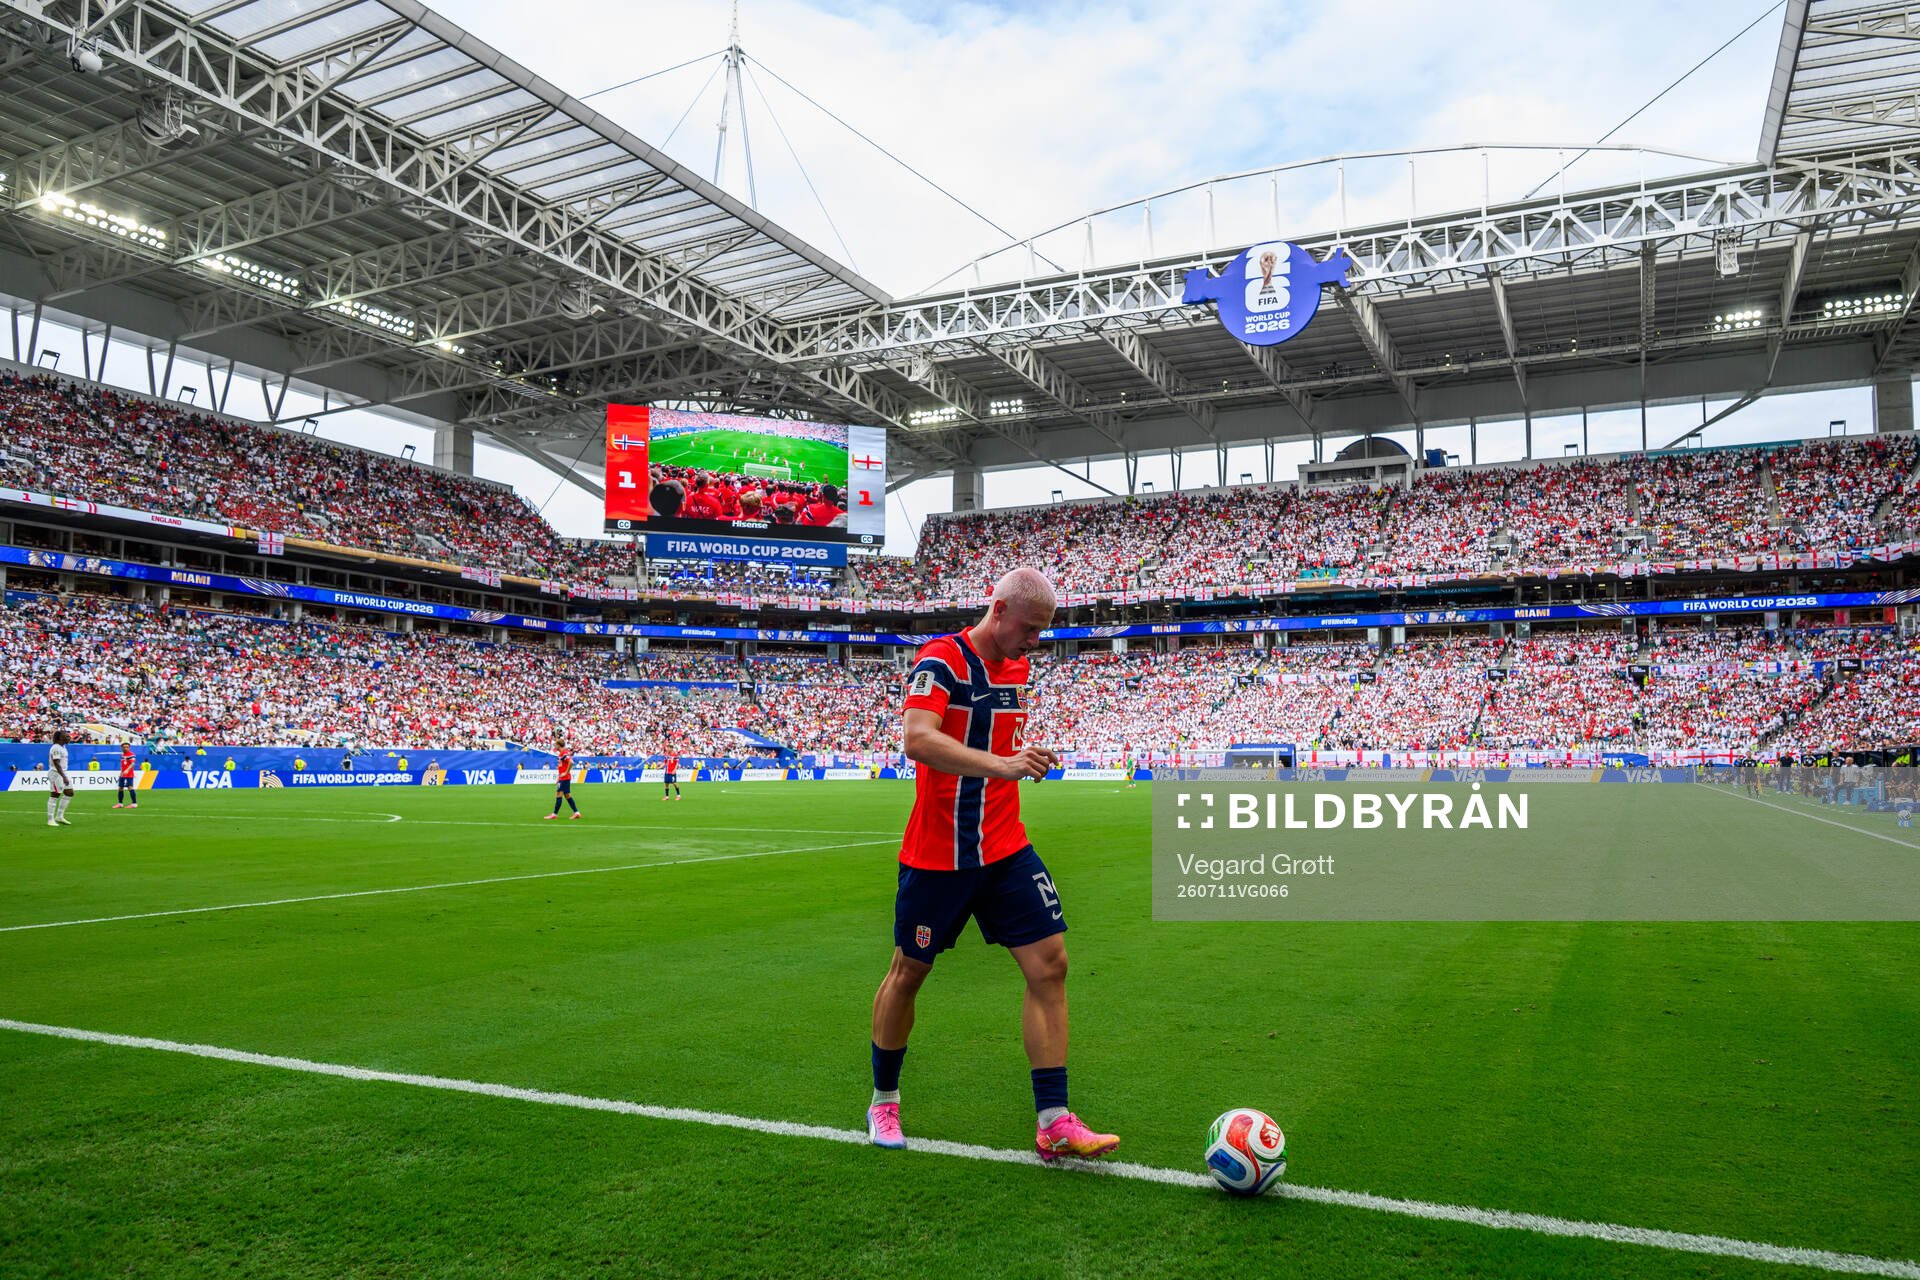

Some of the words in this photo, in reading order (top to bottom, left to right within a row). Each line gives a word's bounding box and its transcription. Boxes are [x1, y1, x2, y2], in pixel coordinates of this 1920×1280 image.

[1258, 296, 1279, 306] FIFA
[1245, 313, 1273, 323] WORLD
[1275, 311, 1291, 320] CUP
[1245, 320, 1291, 334] 2026
[618, 471, 636, 489] 1
[22, 493, 32, 502] 1
[858, 490, 874, 506] 1
[151, 515, 182, 526] ENGLAND
[618, 521, 631, 529] CC
[732, 520, 768, 530] Hisense
[862, 535, 873, 543] CC
[667, 541, 697, 553] FIFA
[700, 542, 750, 555] WORLD
[752, 545, 779, 557] CUP
[781, 546, 828, 559] 2026
[171, 571, 211, 585] MIAMI
[335, 594, 354, 604] FIFA
[355, 596, 386, 608] WORLD
[388, 600, 404, 610] CUP
[405, 604, 434, 614] 2026
[1683, 601, 1707, 611] FIFA
[1709, 600, 1750, 610] WORLD
[1751, 598, 1775, 608] CUP
[1776, 597, 1817, 607] 2026
[1515, 608, 1550, 618] MIAMI
[523, 618, 547, 628] MIAMI
[1152, 624, 1181, 633] MIAMI
[849, 634, 877, 642] MIAMI
[21, 776, 87, 785] MARTT
[182, 770, 233, 788] VISA
[293, 774, 317, 784] FIFA
[318, 774, 355, 784] WORLD
[356, 774, 376, 784] CUP
[375, 773, 411, 784] 2026
[462, 769, 496, 785] VISA
[600, 769, 626, 783] VISA
[709, 769, 730, 782] VISA
[797, 769, 815, 781] VISA
[895, 768, 916, 781] VIS
[1152, 768, 1180, 781] VISA
[1295, 769, 1326, 782] VISA
[1351, 772, 1388, 780] MARRIOTT
[1449, 769, 1487, 782] VISA
[1622, 769, 1662, 783] VISA
[1032, 871, 1059, 908] 2
